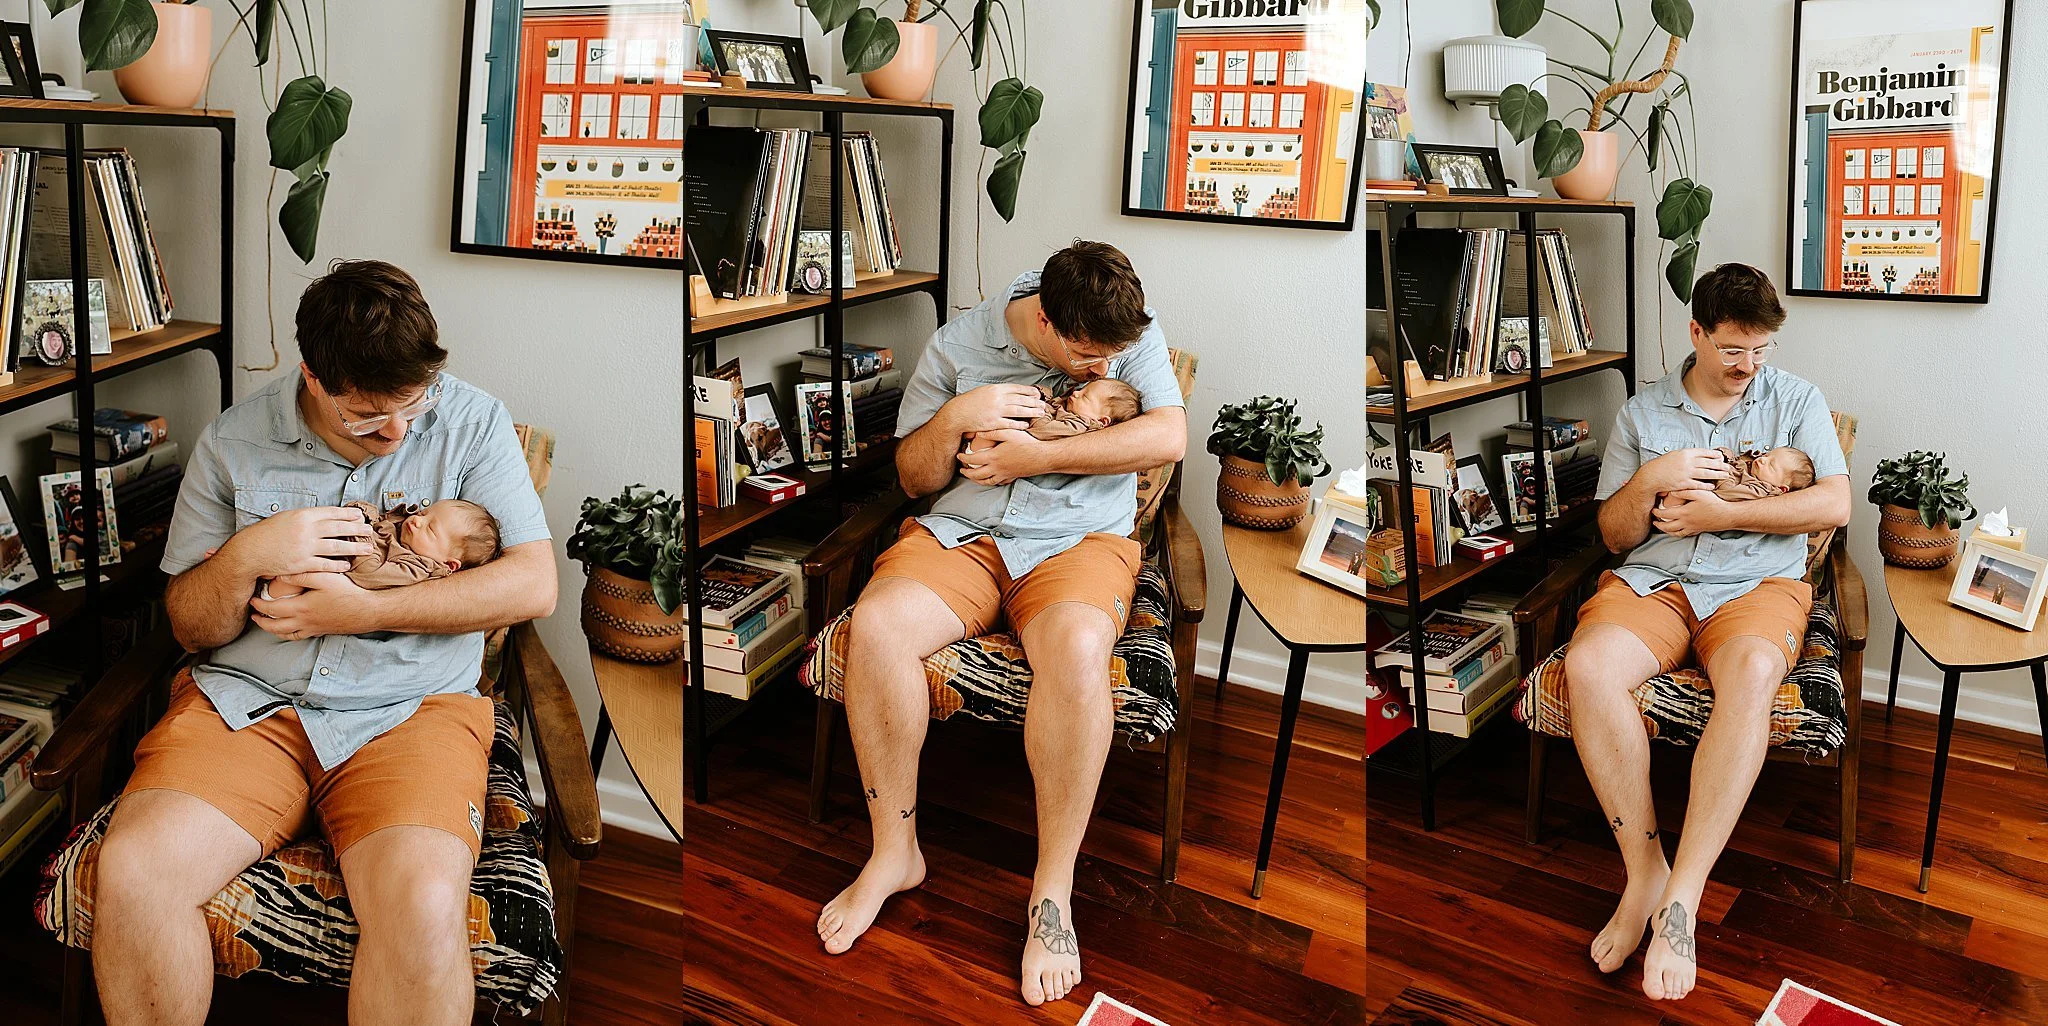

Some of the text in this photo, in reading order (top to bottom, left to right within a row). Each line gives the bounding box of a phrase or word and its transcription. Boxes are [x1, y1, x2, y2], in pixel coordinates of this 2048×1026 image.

[1817, 63, 1966, 97] Benjamin
[1834, 92, 1960, 121] Gibbard
[689, 384, 709, 403] RE
[1407, 457, 1425, 474] RE
